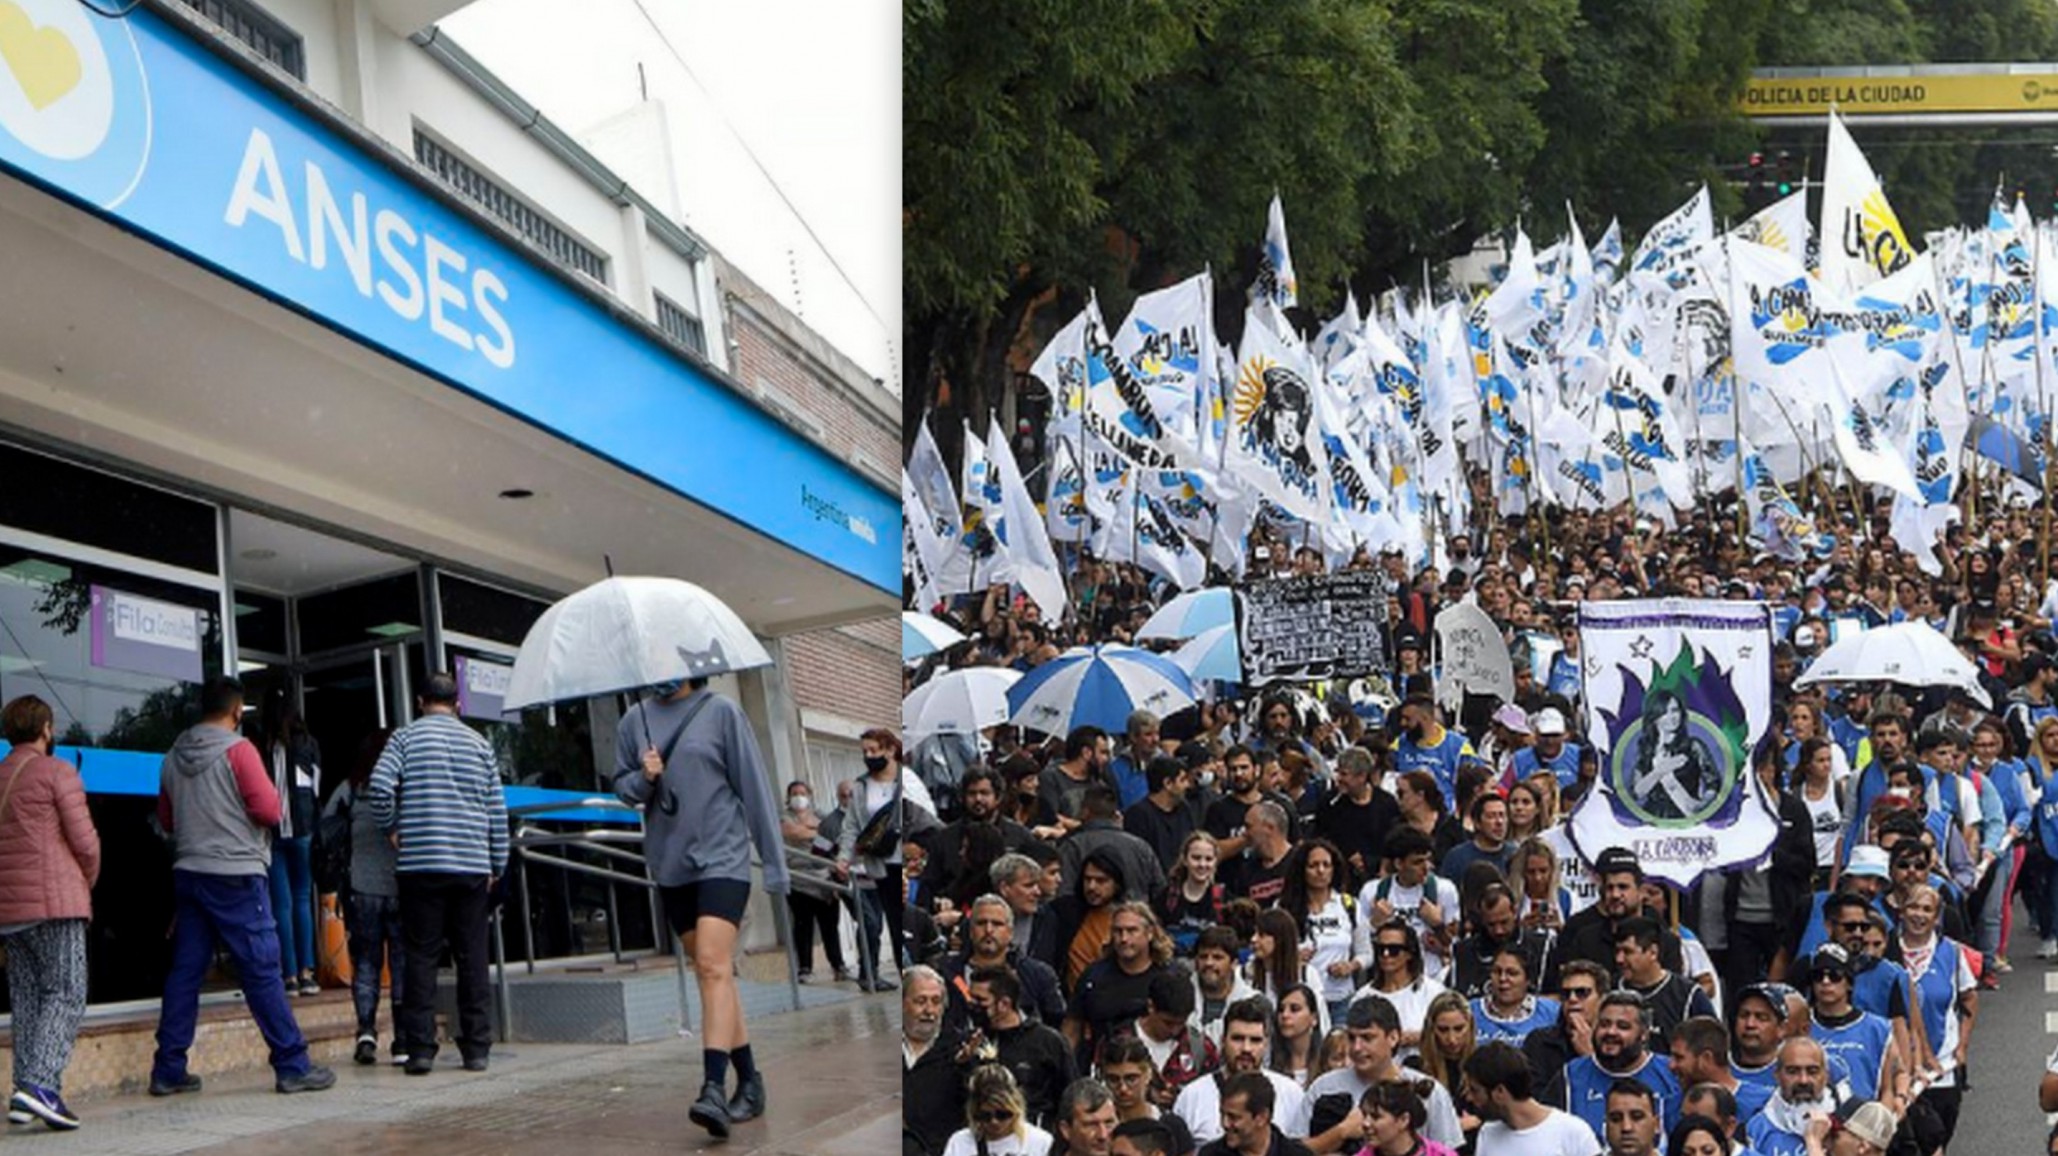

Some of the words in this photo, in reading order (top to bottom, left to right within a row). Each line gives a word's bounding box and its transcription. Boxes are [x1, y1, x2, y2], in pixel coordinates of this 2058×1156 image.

[1807, 87, 1831, 103] DE
[1835, 86, 1857, 103] LA
[1859, 84, 1926, 103] CIUDAD
[224, 127, 516, 369] ANSES
[116, 603, 155, 635] Fila
